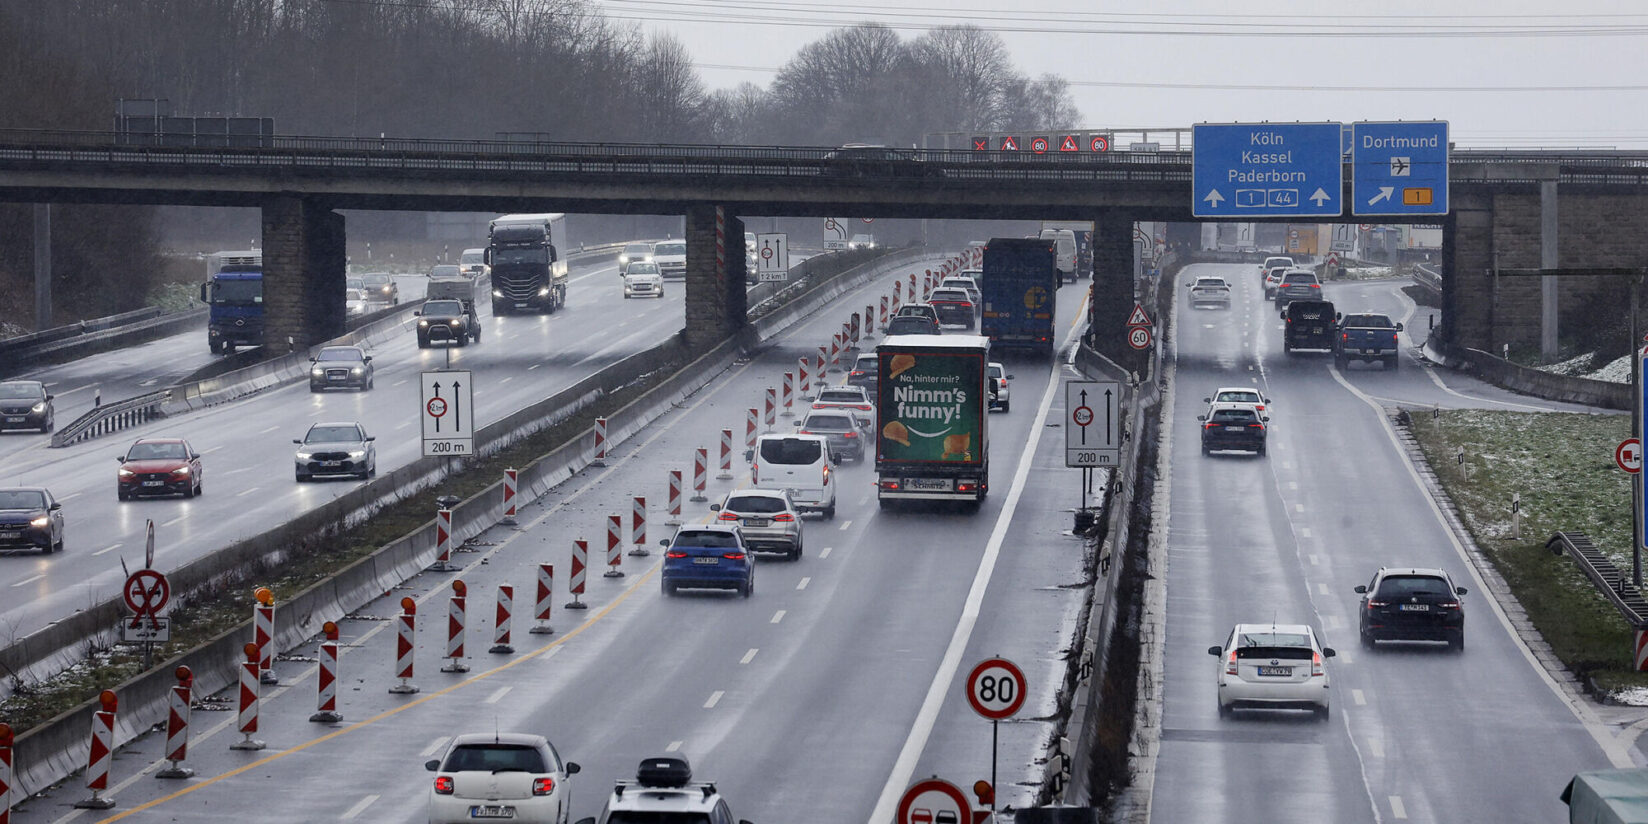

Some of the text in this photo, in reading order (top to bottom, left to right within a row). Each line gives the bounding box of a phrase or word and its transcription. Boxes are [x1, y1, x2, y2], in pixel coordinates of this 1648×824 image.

[1251, 132, 1284, 144] Köln
[1363, 134, 1438, 148] Dortmund
[1242, 150, 1292, 164] Kassel
[1228, 169, 1306, 182] Paderborn
[1275, 192, 1291, 204] 44
[1133, 332, 1146, 343] 60
[900, 374, 960, 383] Na, hinter mir?
[897, 402, 960, 424] funny!
[432, 442, 464, 452] 200 m
[1078, 452, 1096, 463] 200
[980, 675, 1014, 703] 80
